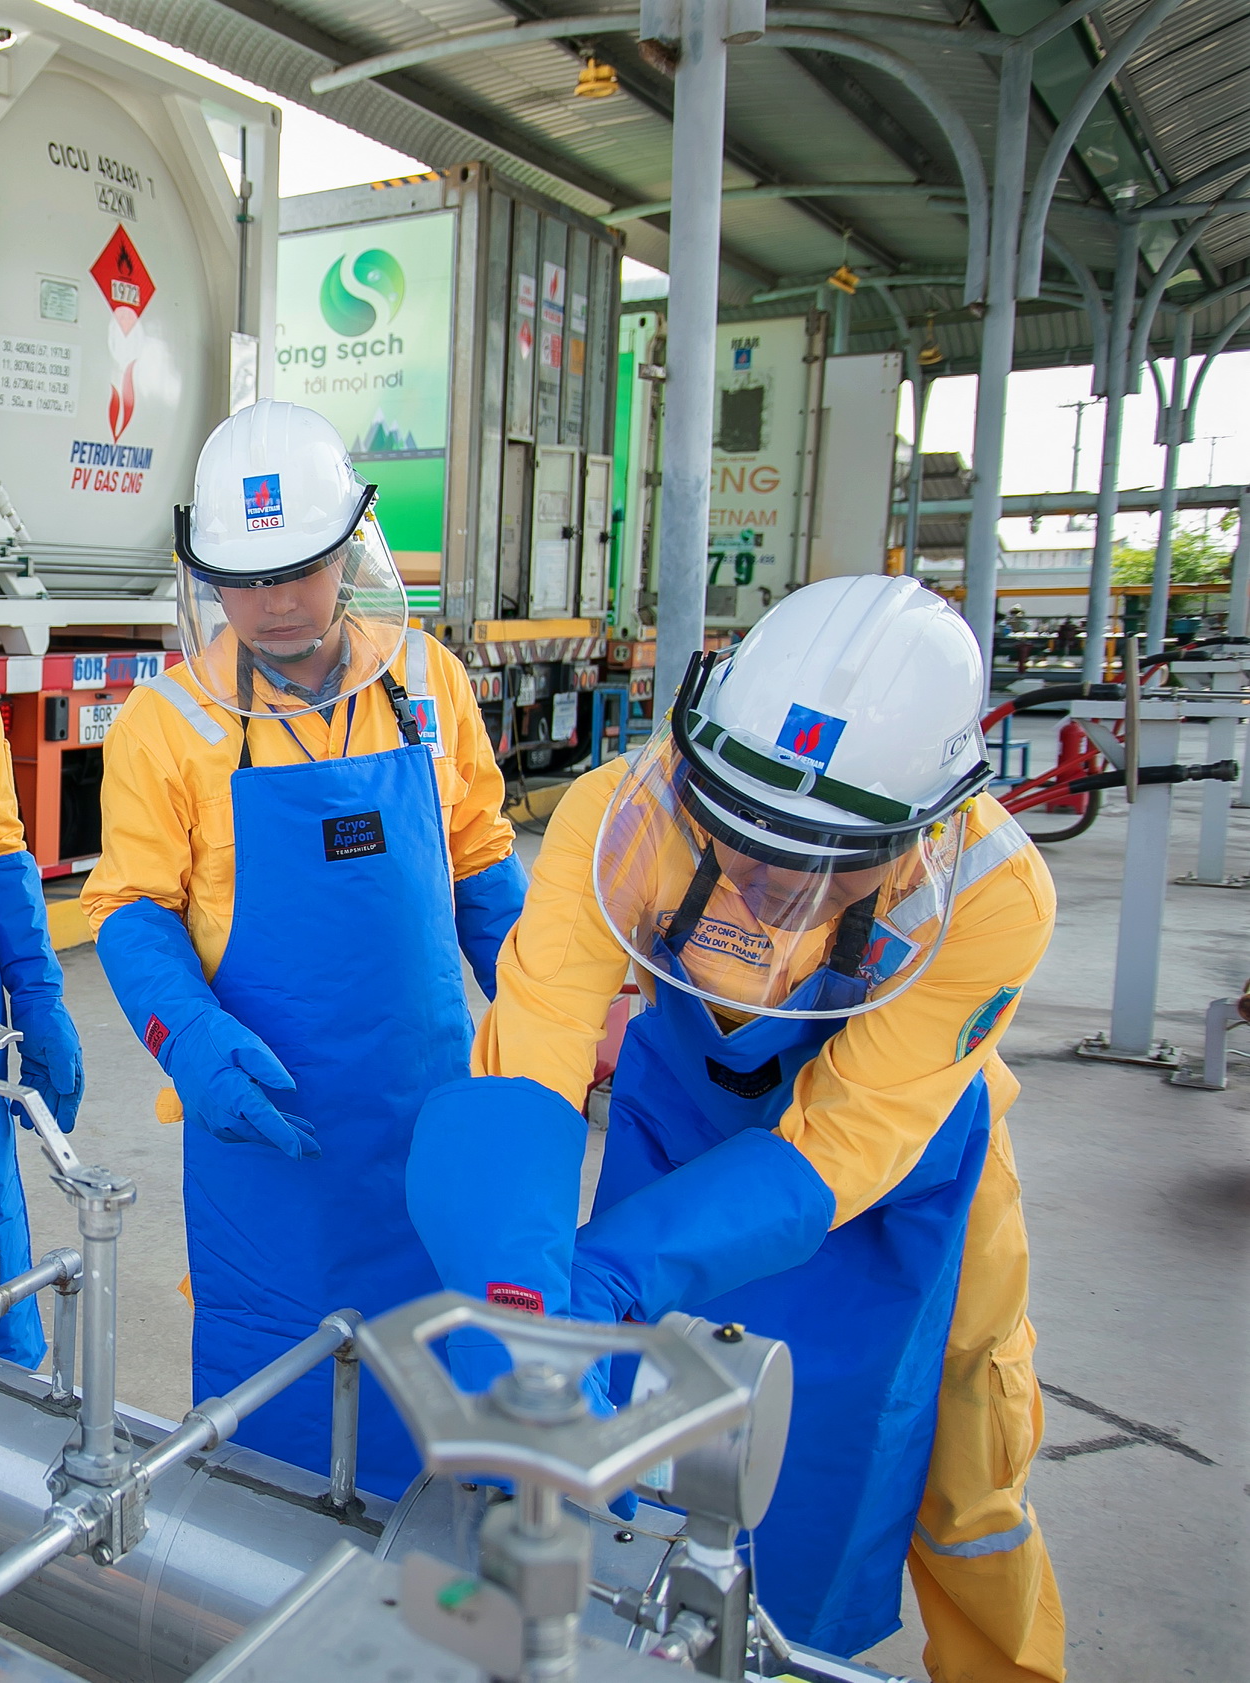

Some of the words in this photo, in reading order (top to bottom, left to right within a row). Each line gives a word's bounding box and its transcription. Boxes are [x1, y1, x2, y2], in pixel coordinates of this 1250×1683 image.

[48, 142, 90, 172] CICU
[97, 155, 143, 192] 482481
[98, 187, 136, 221] 42KW
[112, 282, 138, 304] 1972
[275, 344, 327, 372] ợng
[337, 332, 403, 365] sạch
[70, 440, 153, 469] PETROVIETNAM
[71, 467, 92, 490] PV
[94, 469, 119, 492] GAS
[121, 471, 143, 493] CNG
[252, 517, 279, 529] CNG
[710, 508, 777, 526] ETNAM
[73, 655, 158, 681] 60R-07070
[93, 706, 112, 722] 60R
[85, 723, 112, 740] 070
[335, 820, 371, 833] Cryo-
[334, 831, 374, 847] Apron
[719, 926, 737, 937] CNG
[712, 938, 729, 949] DUY
[731, 943, 761, 960] THANH
[493, 1295, 539, 1310] Gloves
